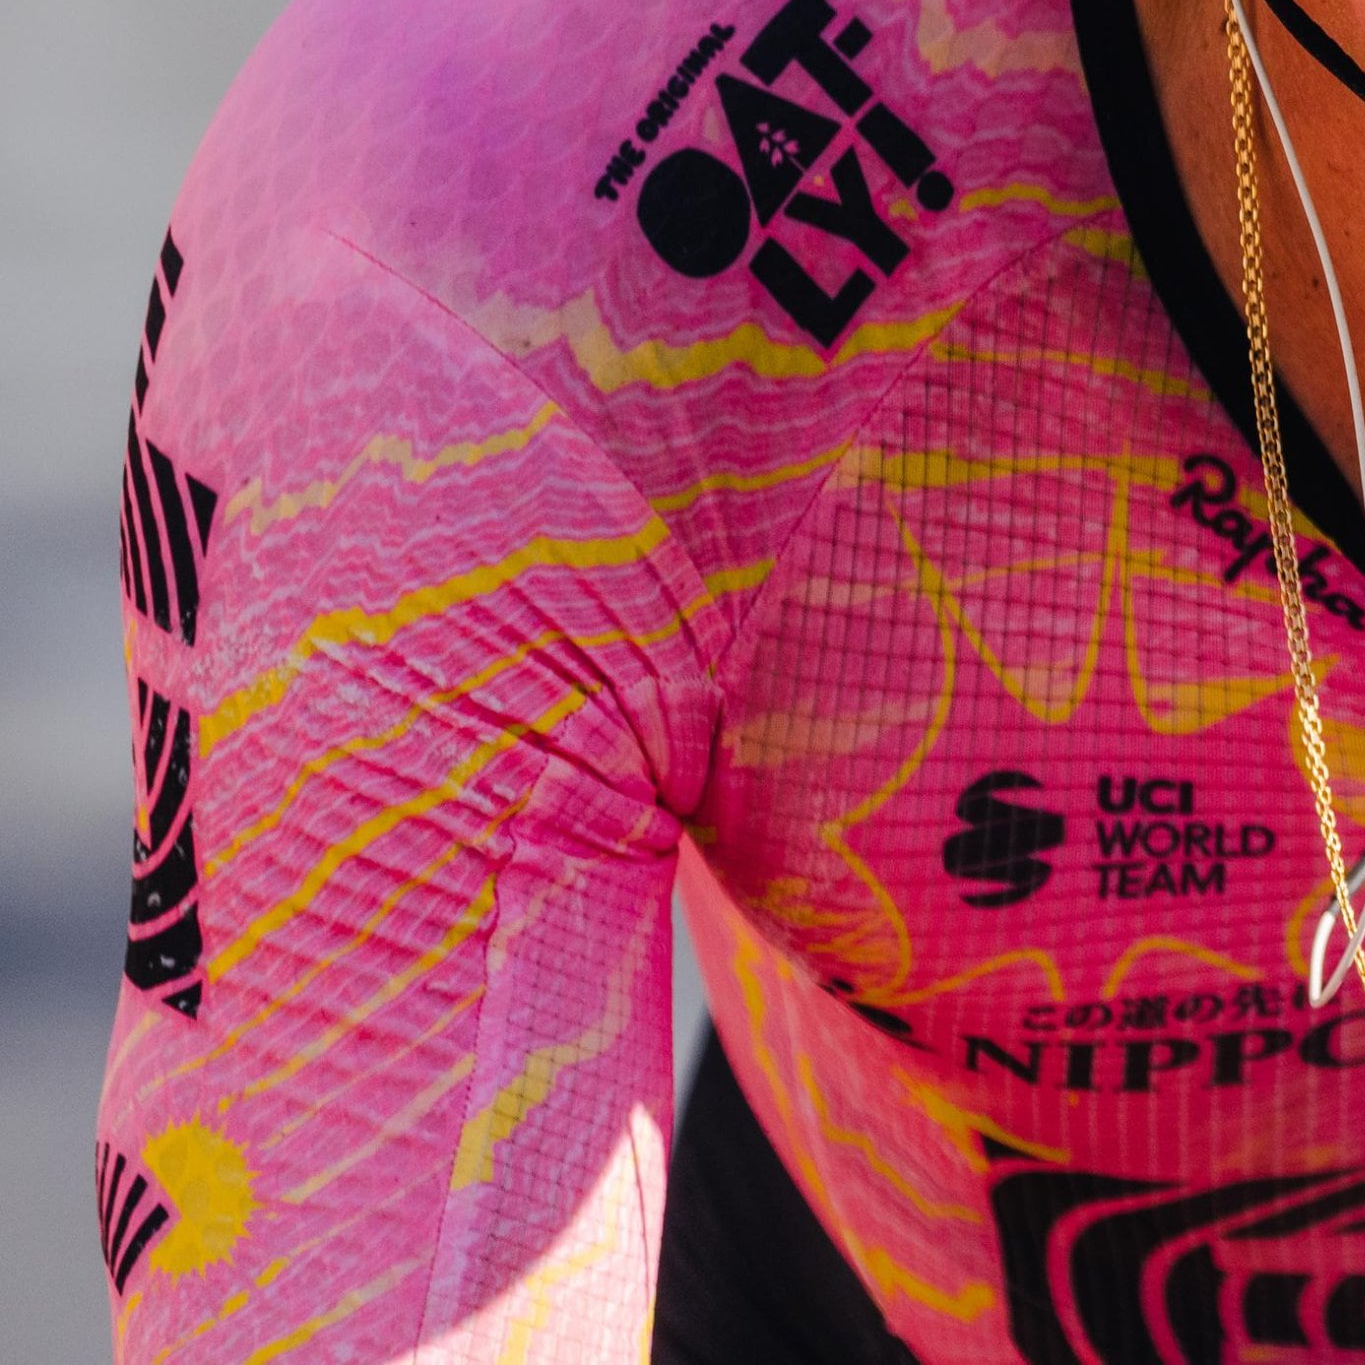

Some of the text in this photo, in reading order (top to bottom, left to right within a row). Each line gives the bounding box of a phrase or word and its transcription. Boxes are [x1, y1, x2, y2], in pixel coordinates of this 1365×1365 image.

[594, 23, 736, 201] THE ORIGINAL
[1099, 776, 1194, 816] UCI
[1096, 821, 1275, 859] WORLD
[1093, 862, 1226, 900] TEAM
